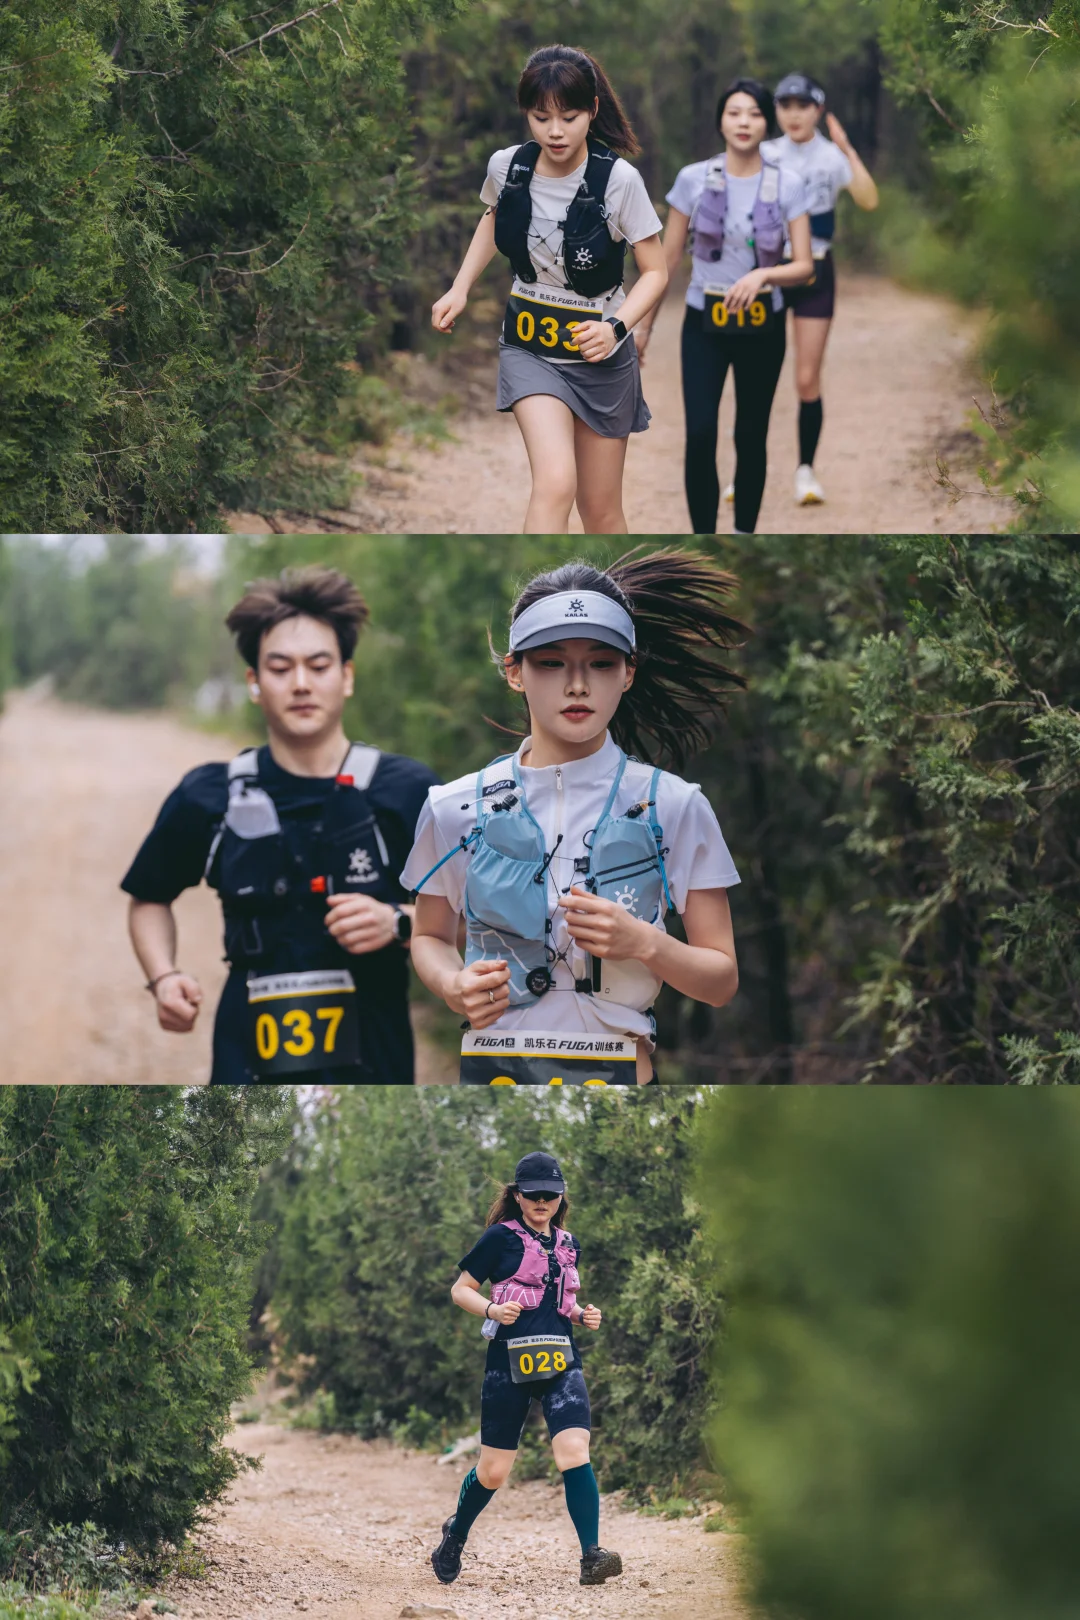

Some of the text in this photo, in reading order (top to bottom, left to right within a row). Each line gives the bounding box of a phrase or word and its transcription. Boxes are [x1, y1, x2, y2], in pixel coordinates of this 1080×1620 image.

[711, 300, 766, 327] 019
[485, 781, 511, 794] FUGA
[256, 1006, 345, 1060] 037
[473, 1038, 505, 1047] FUGA
[519, 1351, 567, 1375] 028
